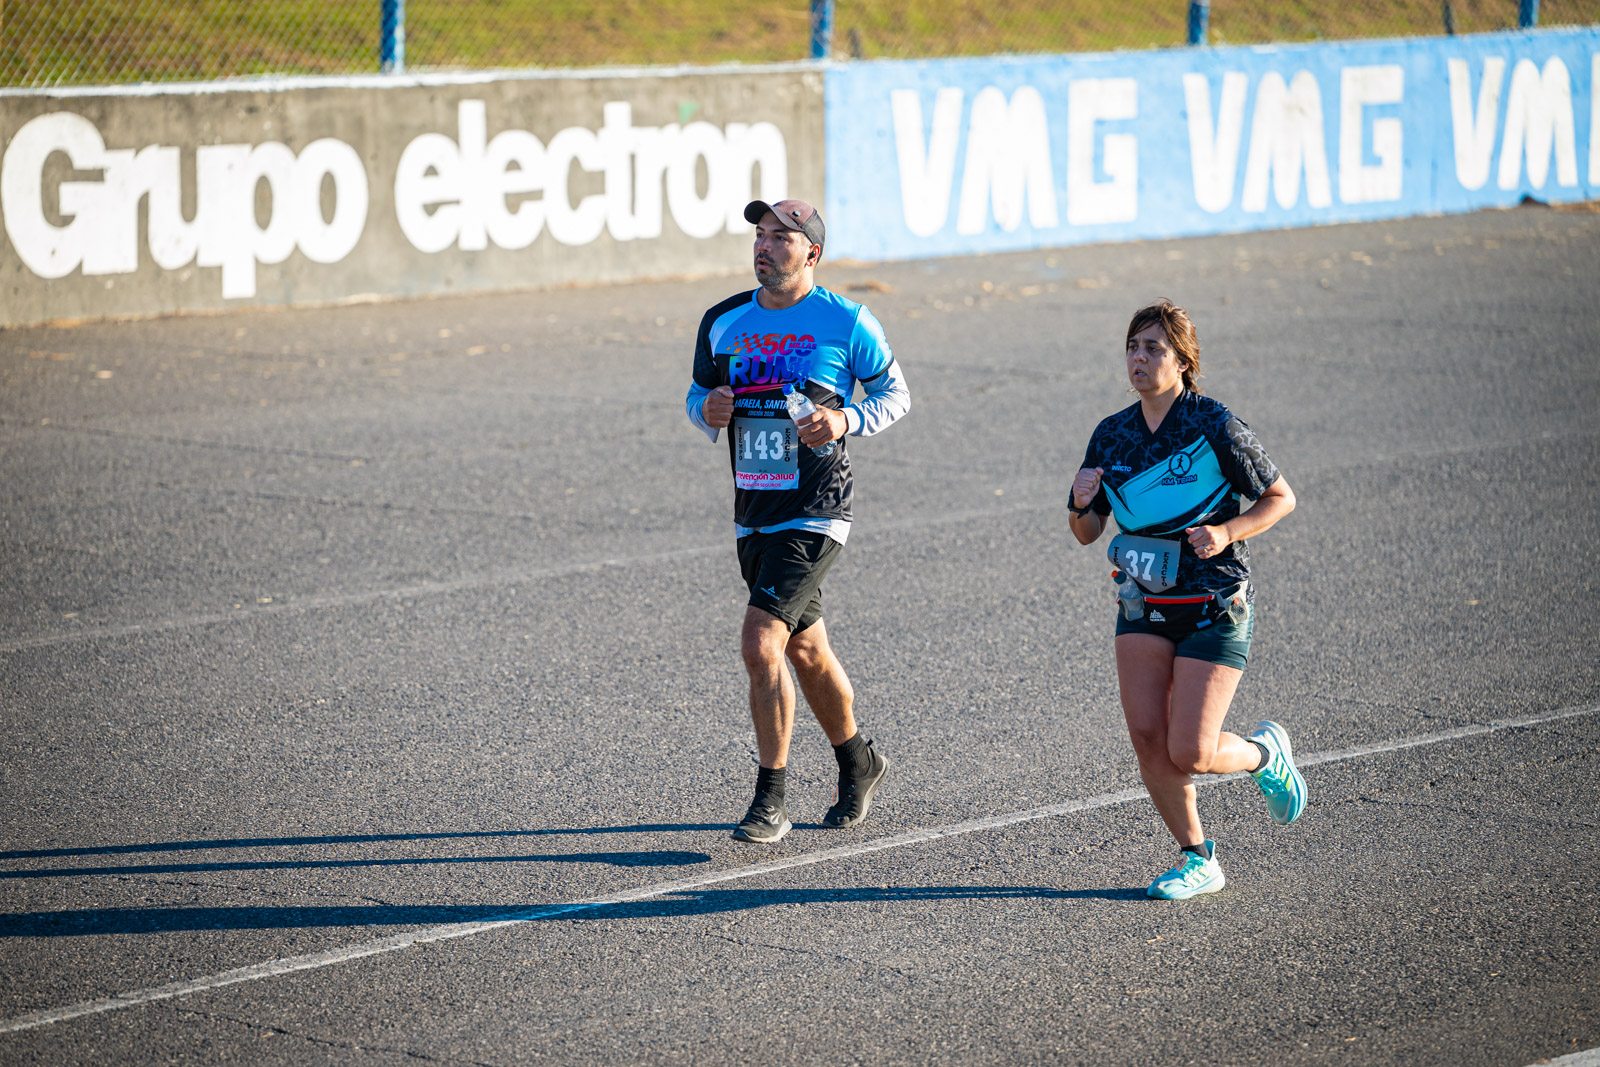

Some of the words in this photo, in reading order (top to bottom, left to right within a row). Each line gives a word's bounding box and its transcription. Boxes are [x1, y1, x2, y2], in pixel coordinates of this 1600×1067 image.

[890, 77, 1138, 237] VMG
[1182, 65, 1404, 213] VMG
[1447, 53, 1600, 191] VM
[1, 111, 369, 299] Grupo
[789, 342, 817, 350] MILLAS
[743, 430, 784, 461] 143
[1176, 474, 1198, 485] TEAM
[1125, 549, 1156, 582] 37
[1160, 551, 1170, 587] EXACTO
